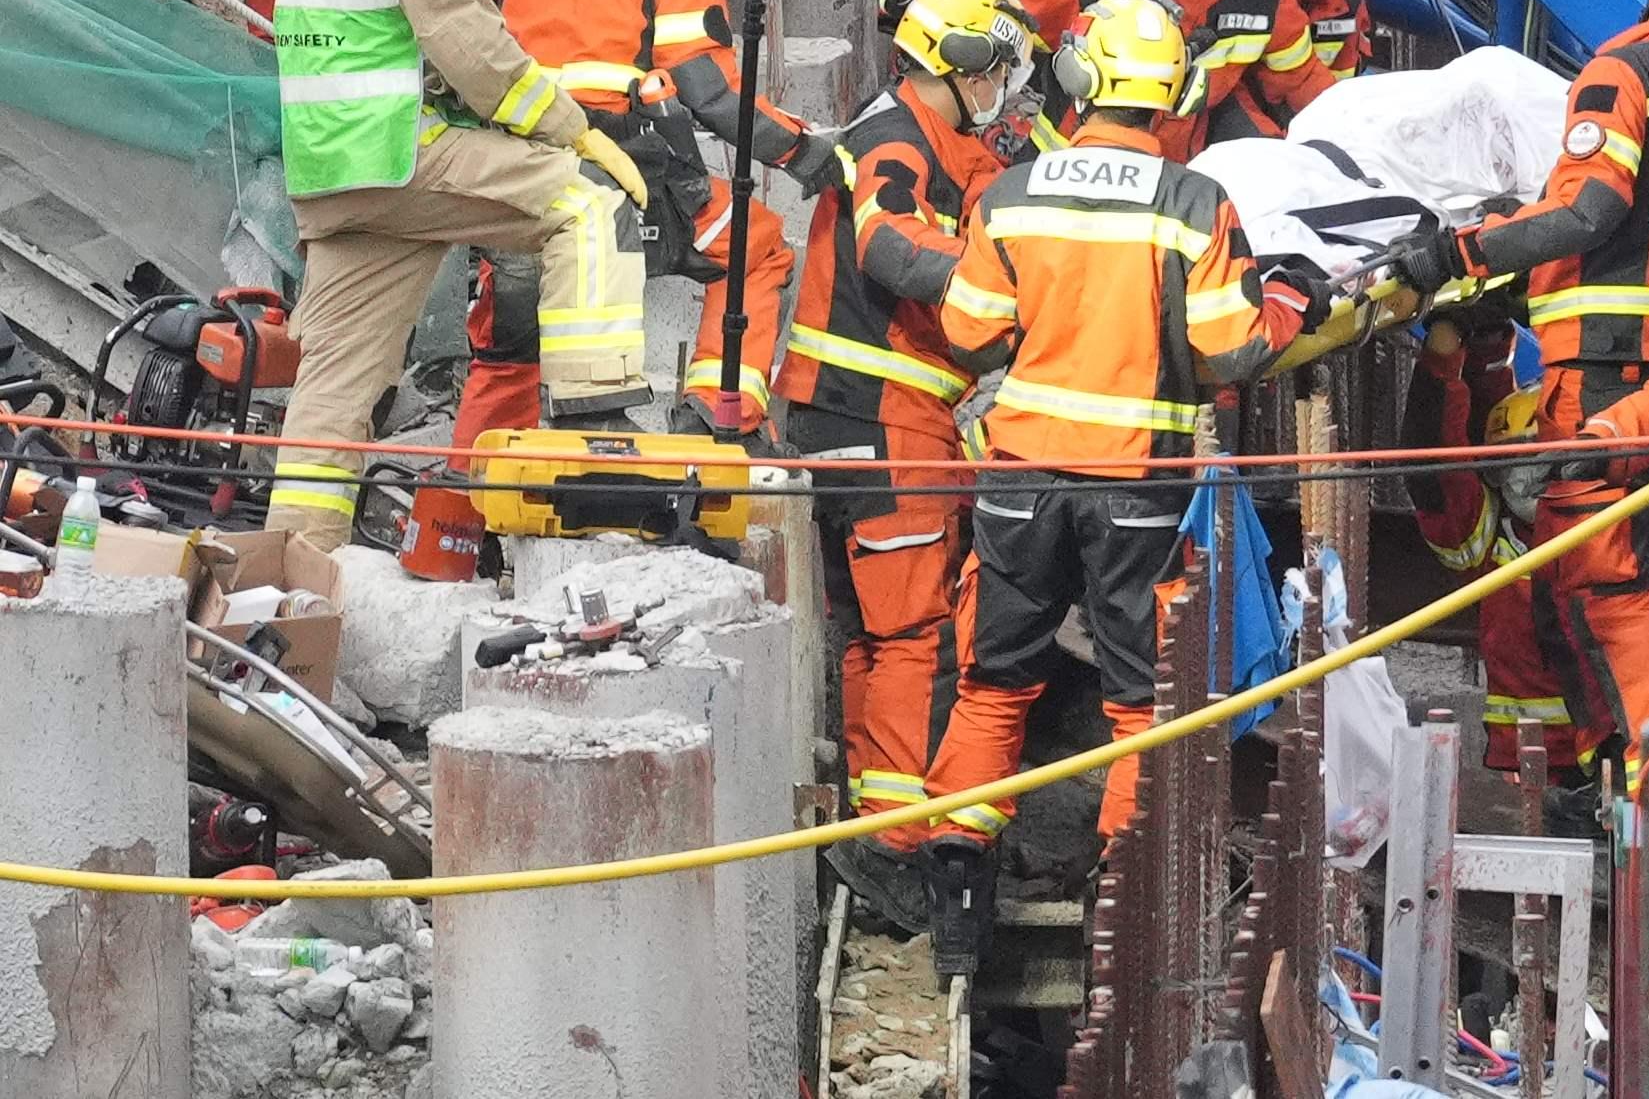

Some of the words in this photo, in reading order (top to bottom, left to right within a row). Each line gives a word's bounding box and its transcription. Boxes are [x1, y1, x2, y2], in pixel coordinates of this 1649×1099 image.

[294, 33, 346, 47] SAFETY
[994, 16, 1025, 52] USAR
[1044, 159, 1141, 188] USAR
